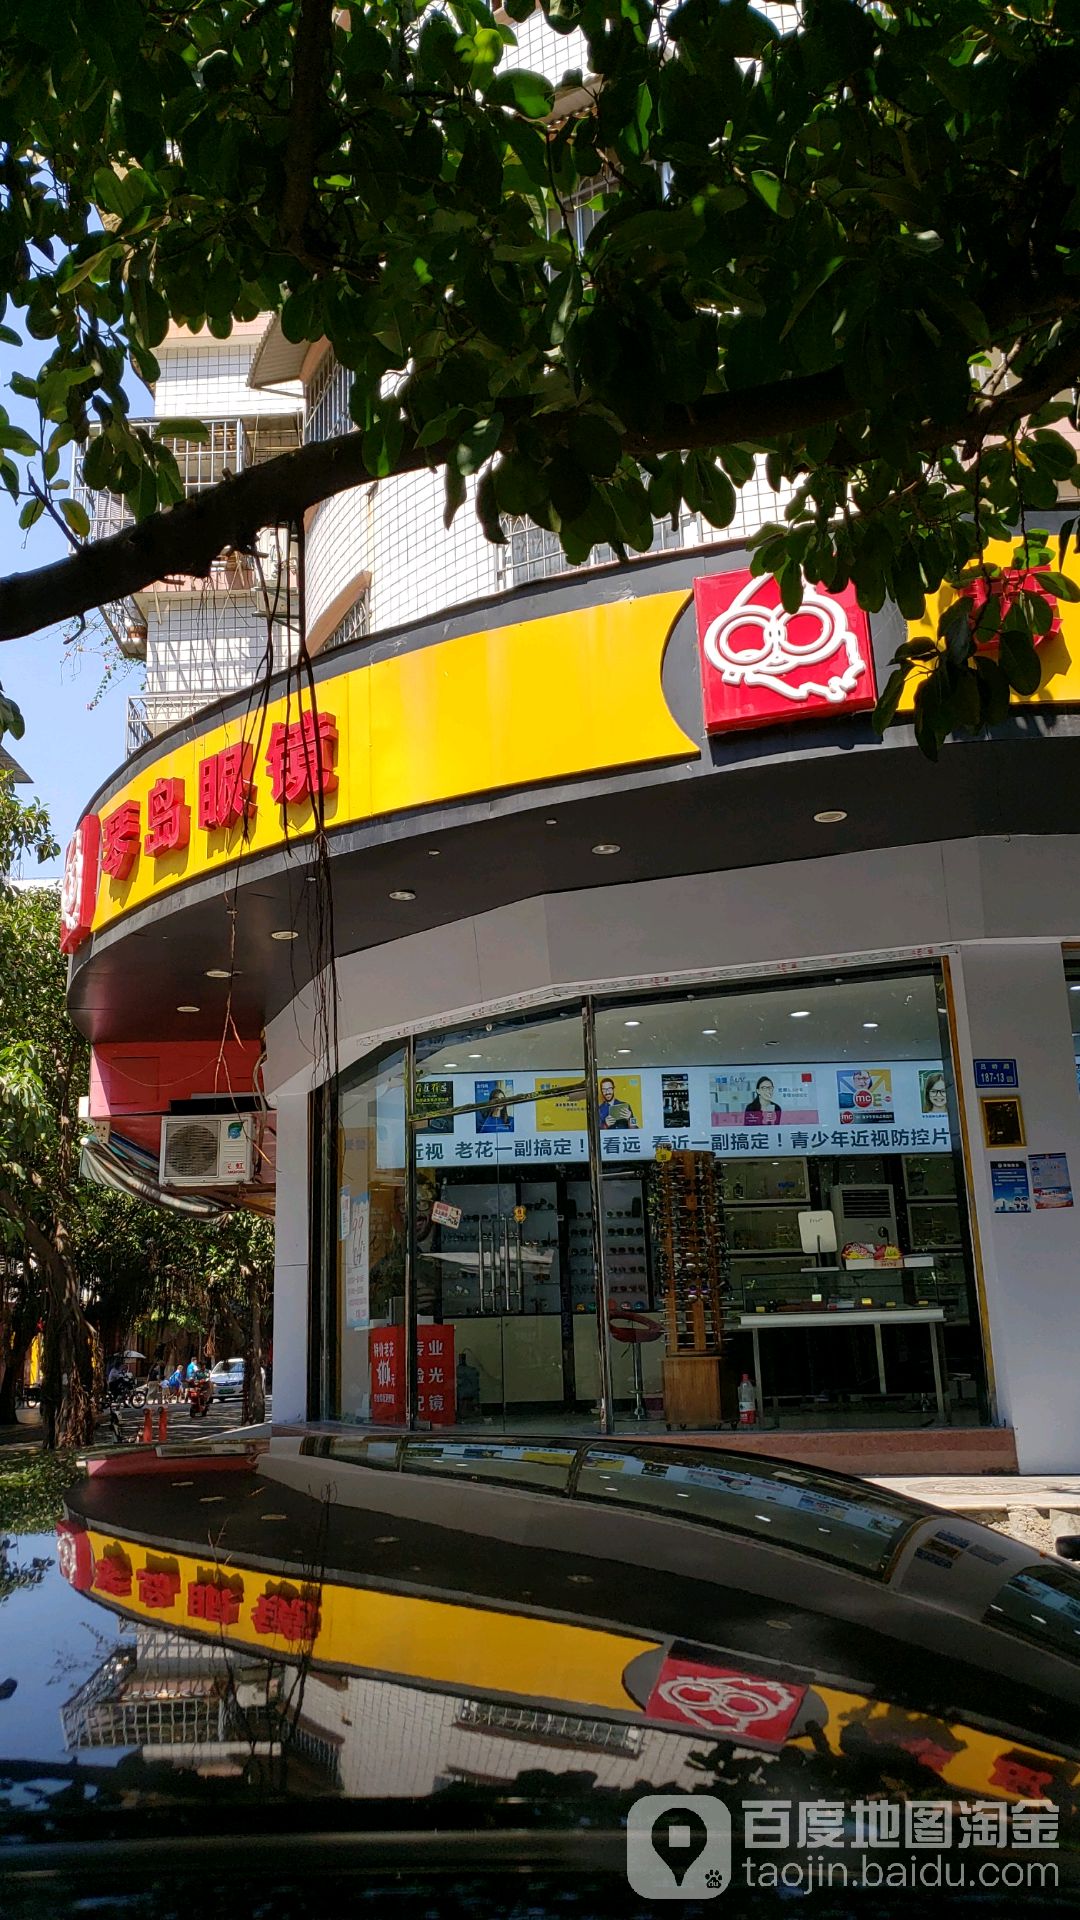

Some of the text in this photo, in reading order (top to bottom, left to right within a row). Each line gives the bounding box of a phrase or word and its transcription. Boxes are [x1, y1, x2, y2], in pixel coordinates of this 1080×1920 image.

[101, 709, 340, 881] 琴岛眼镜
[980, 1072, 1014, 1083] 187-13
[603, 1136, 641, 1154] 看远
